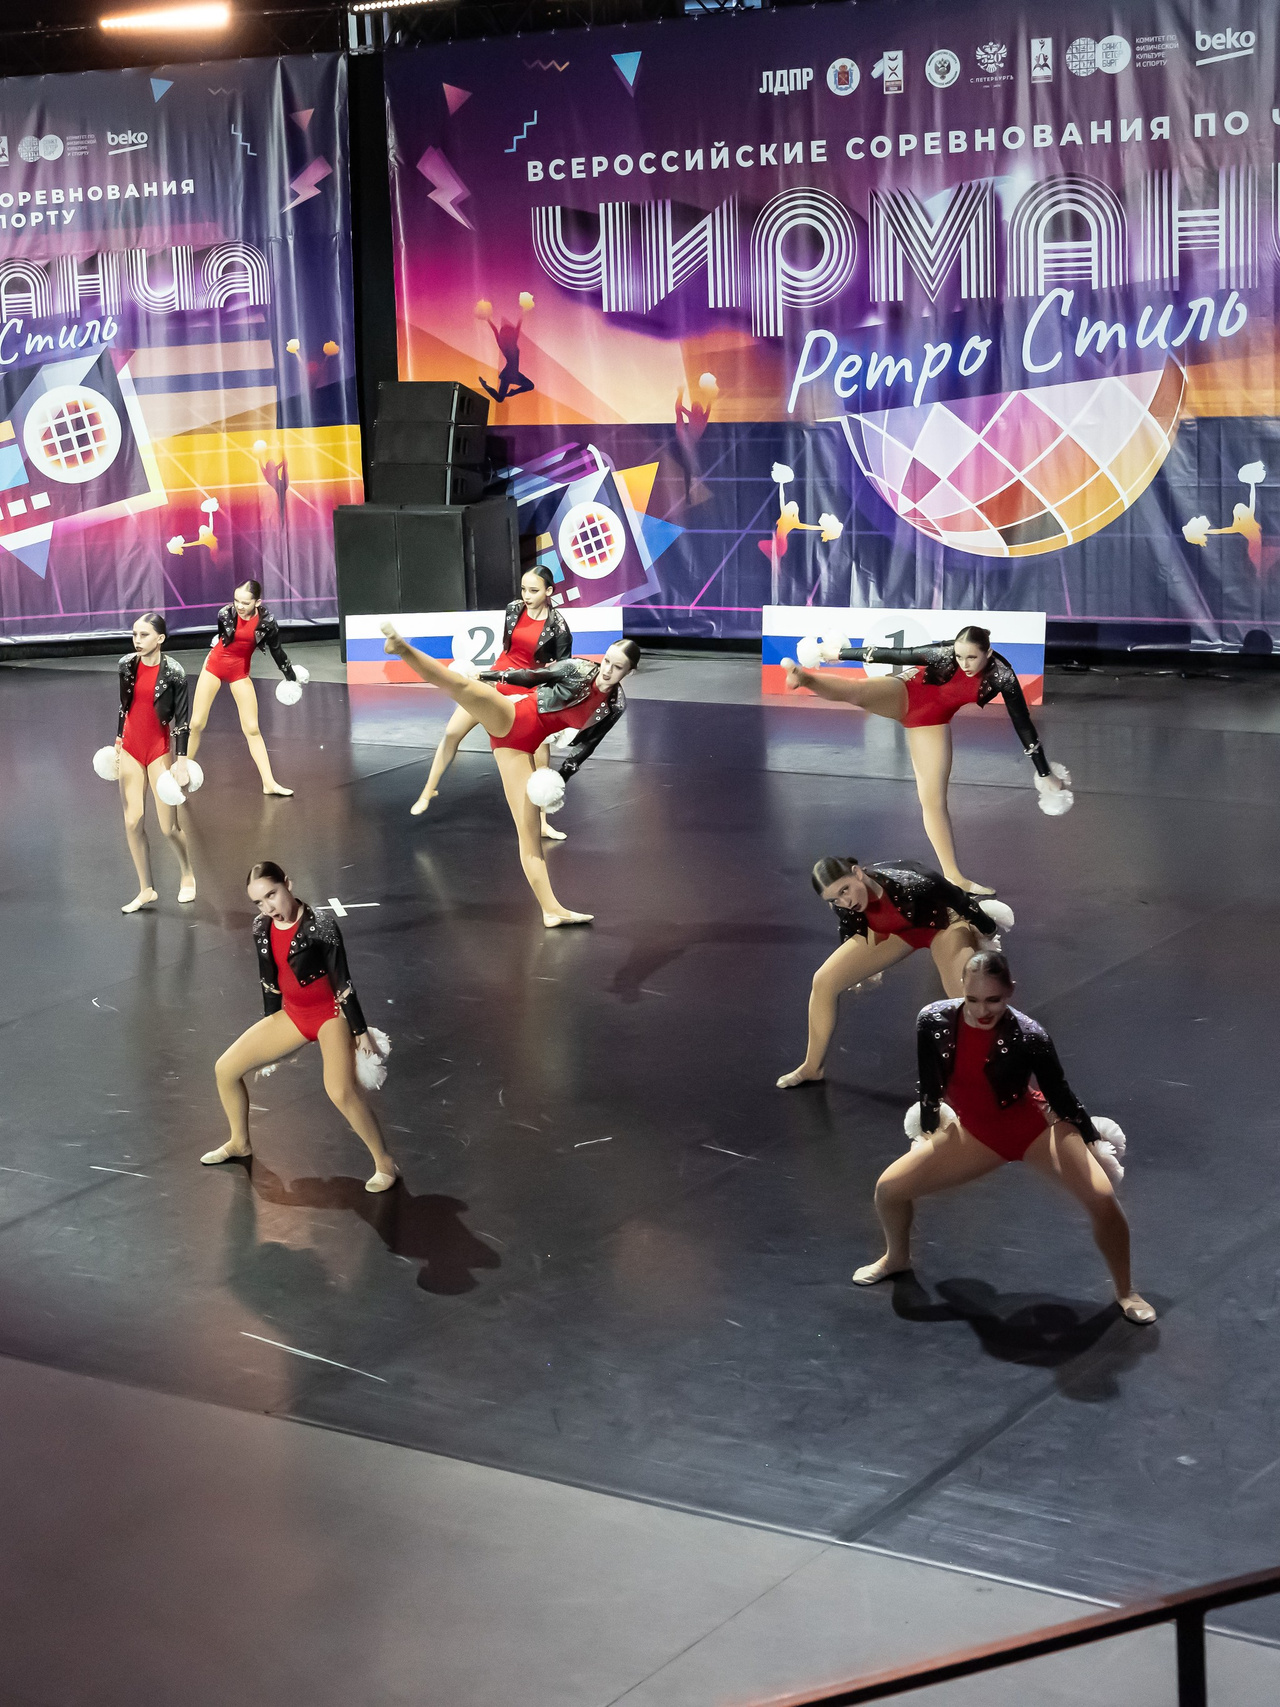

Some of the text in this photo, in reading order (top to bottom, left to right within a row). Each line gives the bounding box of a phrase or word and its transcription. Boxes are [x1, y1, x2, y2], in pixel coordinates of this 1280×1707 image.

[1135, 36, 1165, 44] КОМИТЕТ
[1135, 42, 1179, 52] ФИЗИЧЕСКОЙ
[1195, 27, 1256, 51] beko
[1135, 51, 1166, 60] КУЛЬТУРЕ
[1142, 59, 1168, 68] СПОРТУ
[758, 67, 814, 96] ЛДПР
[107, 130, 149, 146] beko
[526, 139, 828, 182] ВСЕРОССИЙСКИЕ
[845, 115, 1171, 160] СОРЕВНОВАНИЯ
[1193, 110, 1250, 138] ПО
[531, 162, 1280, 337] ЧИРМАН
[787, 287, 1248, 414] Ретро Стиль
[467, 626, 496, 666] 2
[884, 629, 907, 677] 1
